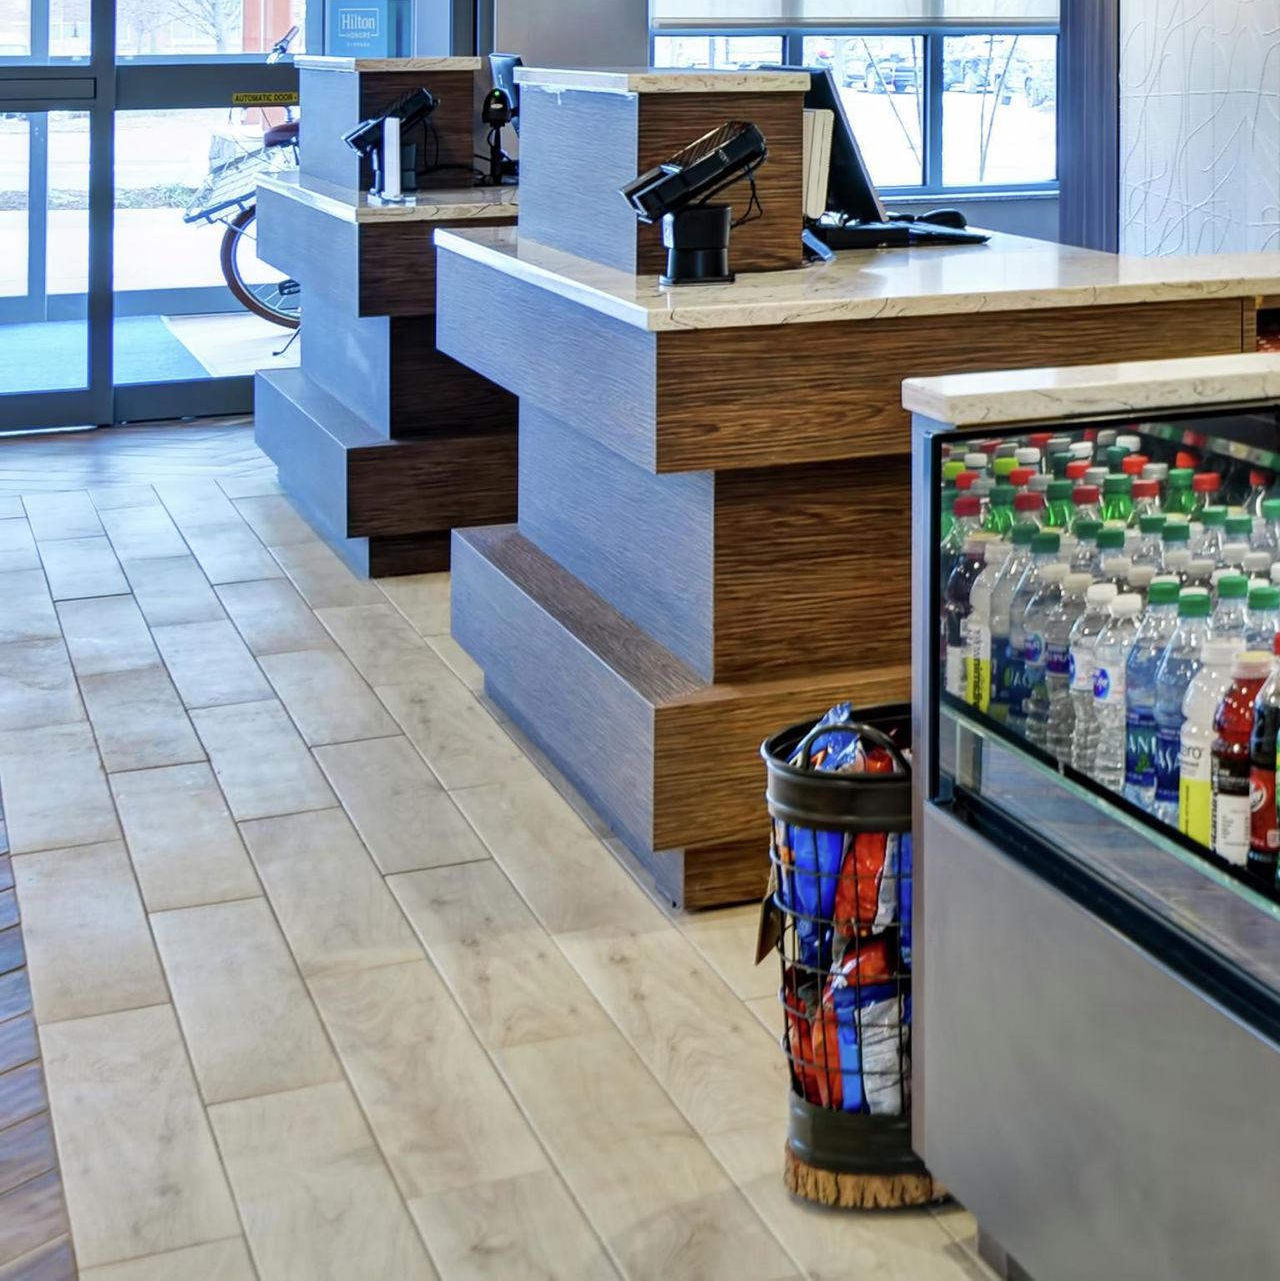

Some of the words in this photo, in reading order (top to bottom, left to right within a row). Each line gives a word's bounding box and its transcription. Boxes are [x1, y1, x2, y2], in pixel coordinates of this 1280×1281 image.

[342, 13, 376, 30] Hilton
[235, 94, 273, 103] AUTOMATIC
[273, 93, 294, 102] DOOR
